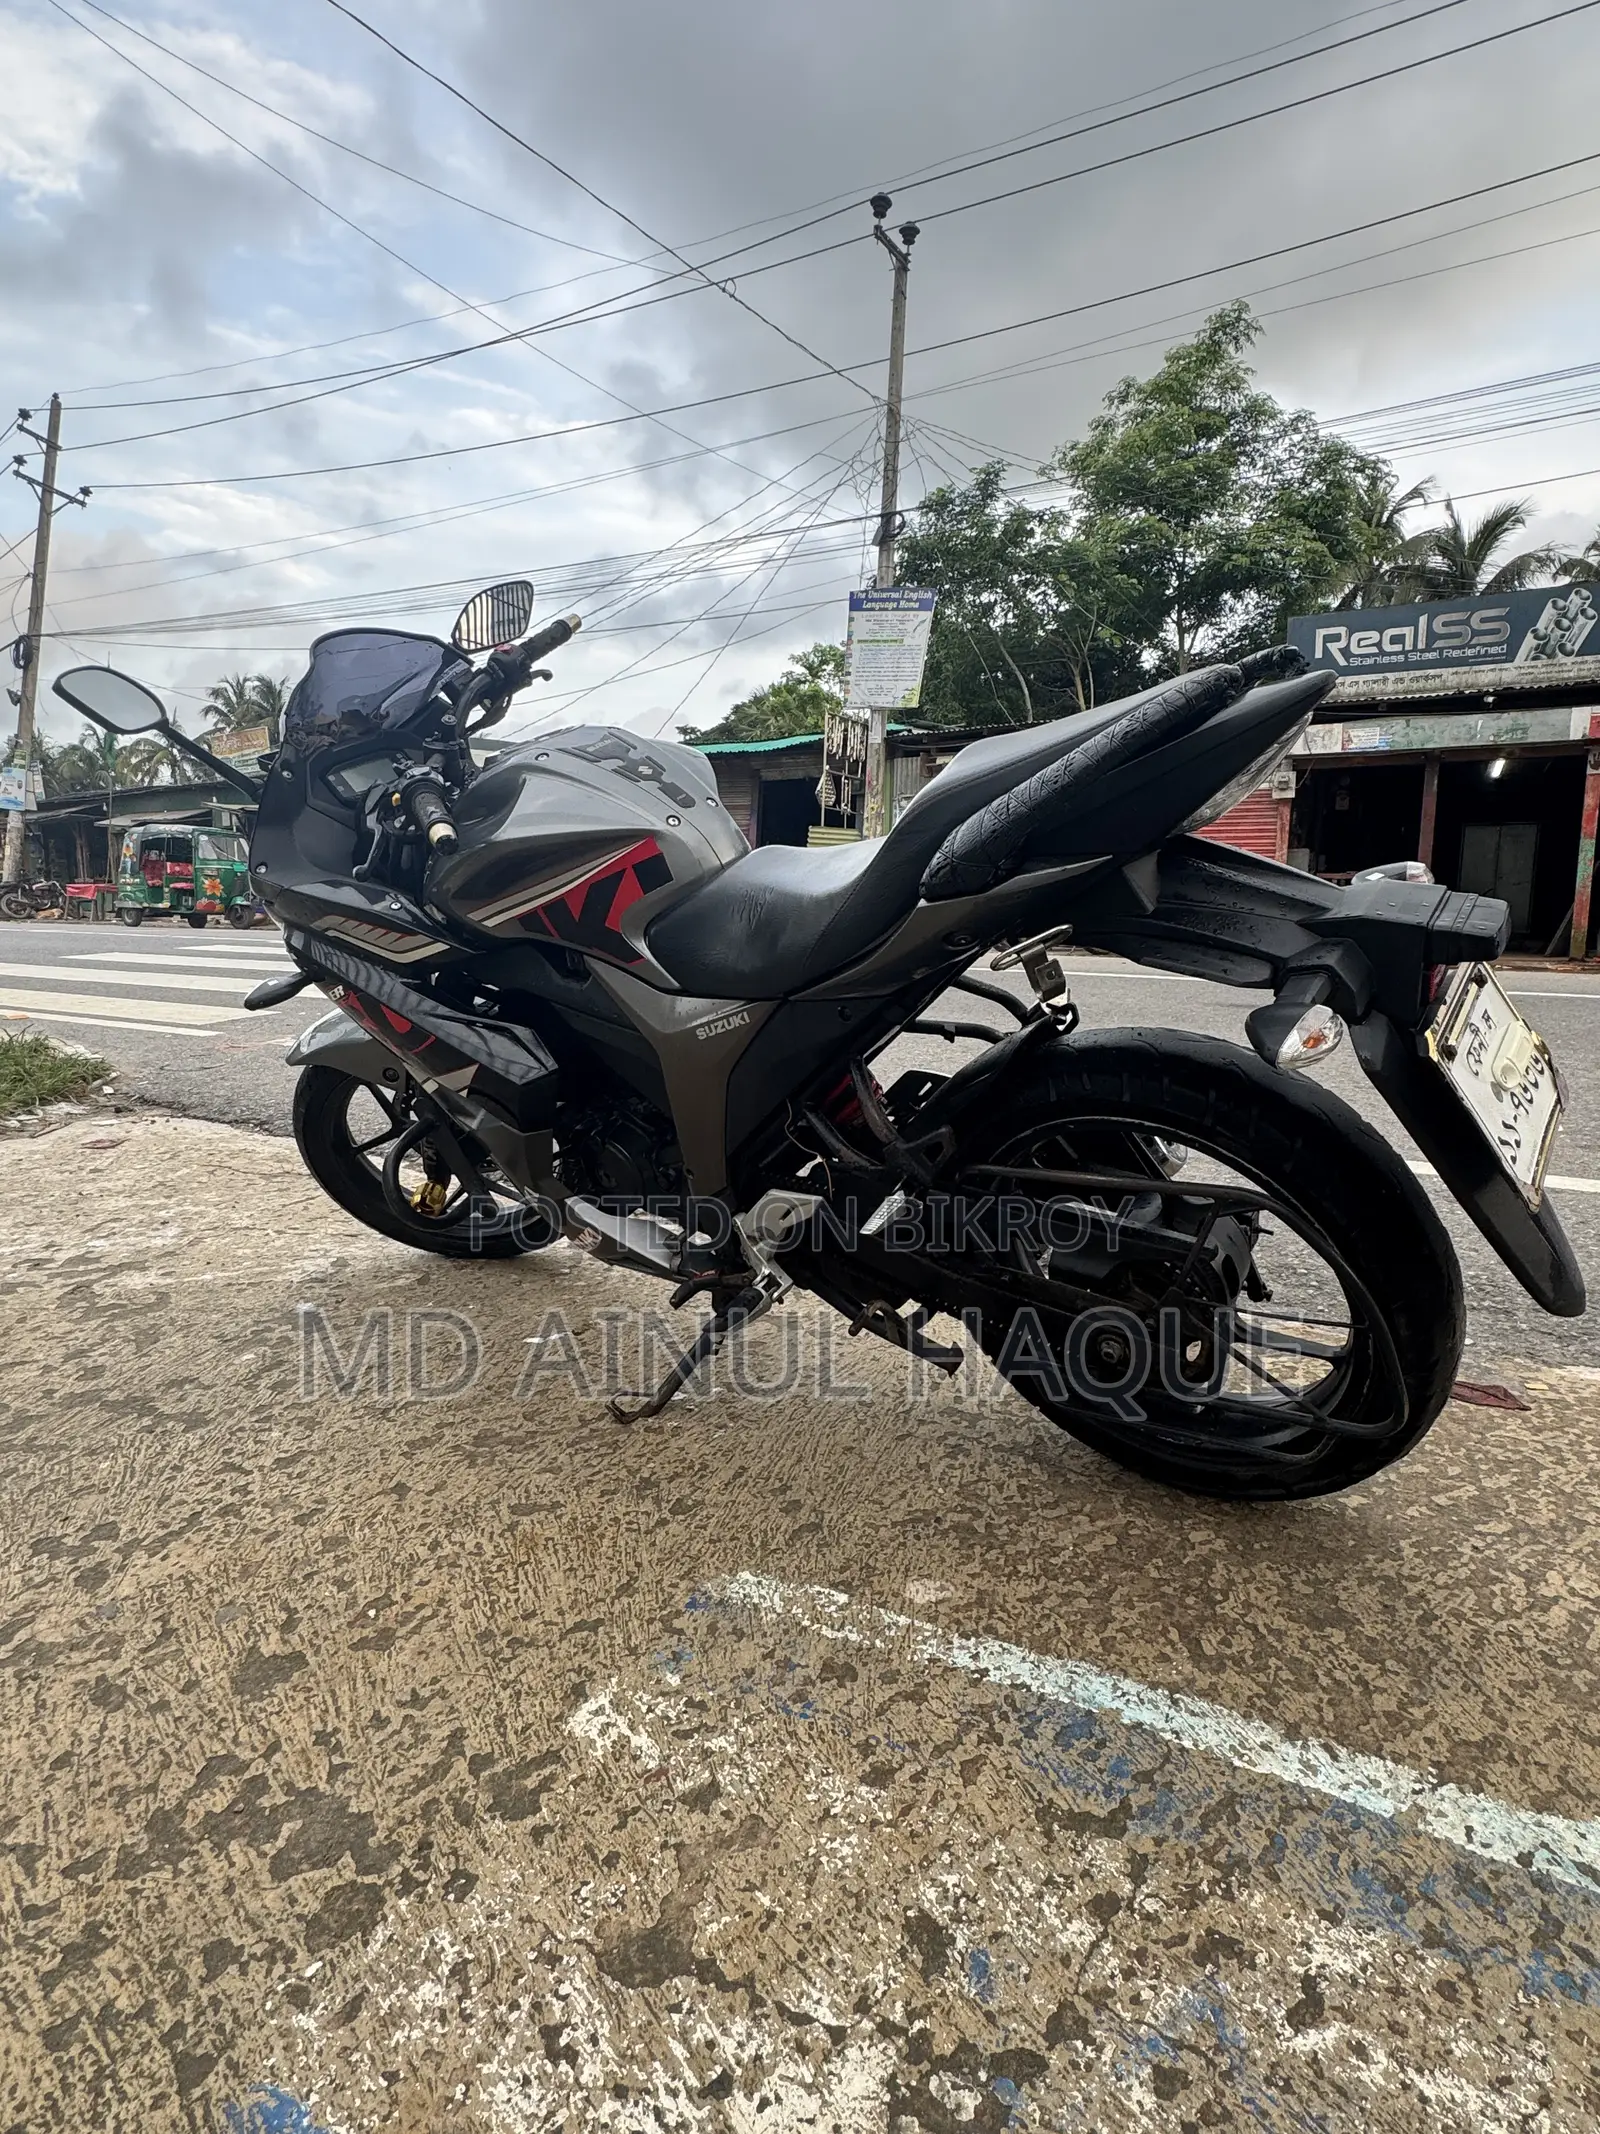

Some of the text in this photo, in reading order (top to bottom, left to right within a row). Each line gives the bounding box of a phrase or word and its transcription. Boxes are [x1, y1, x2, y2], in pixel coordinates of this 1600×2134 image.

[854, 590, 932, 600] The Universal English
[862, 601, 897, 610] Language
[1350, 643, 1507, 667] Stainless Steel Redefined
[695, 1011, 750, 1040] SUZUKI
